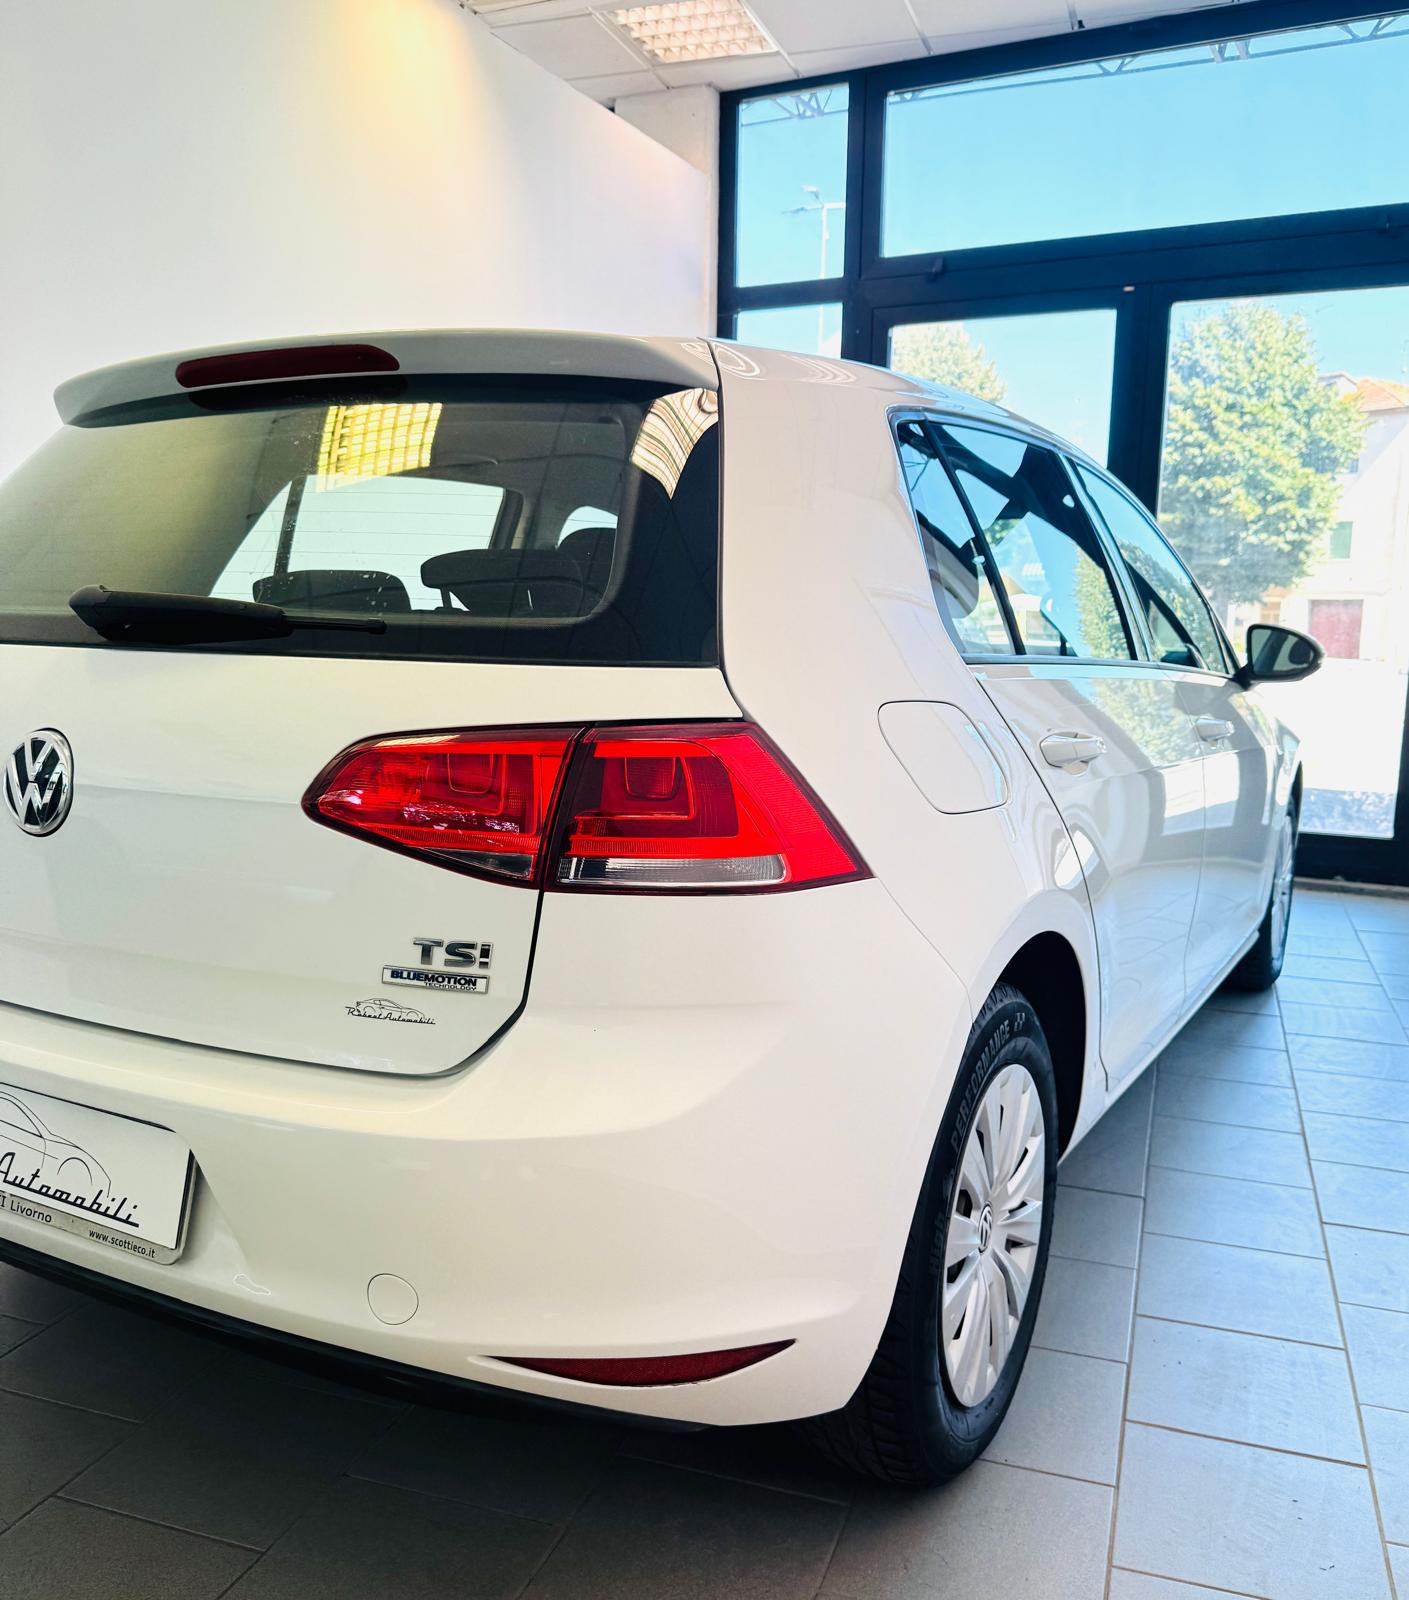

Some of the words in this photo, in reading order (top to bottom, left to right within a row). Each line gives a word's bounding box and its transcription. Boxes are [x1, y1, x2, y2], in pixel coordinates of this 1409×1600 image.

[412, 937, 493, 969] TSI
[390, 969, 478, 987] BLUEMOTION
[424, 982, 477, 991] TECHNOLOGY
[384, 1012, 436, 1025] Automobili
[951, 1019, 1010, 1153] PERFORMANCE
[0, 1152, 139, 1228] Automobili
[10, 1199, 52, 1223] Livorno
[89, 1229, 156, 1258] www.scottieco.it
